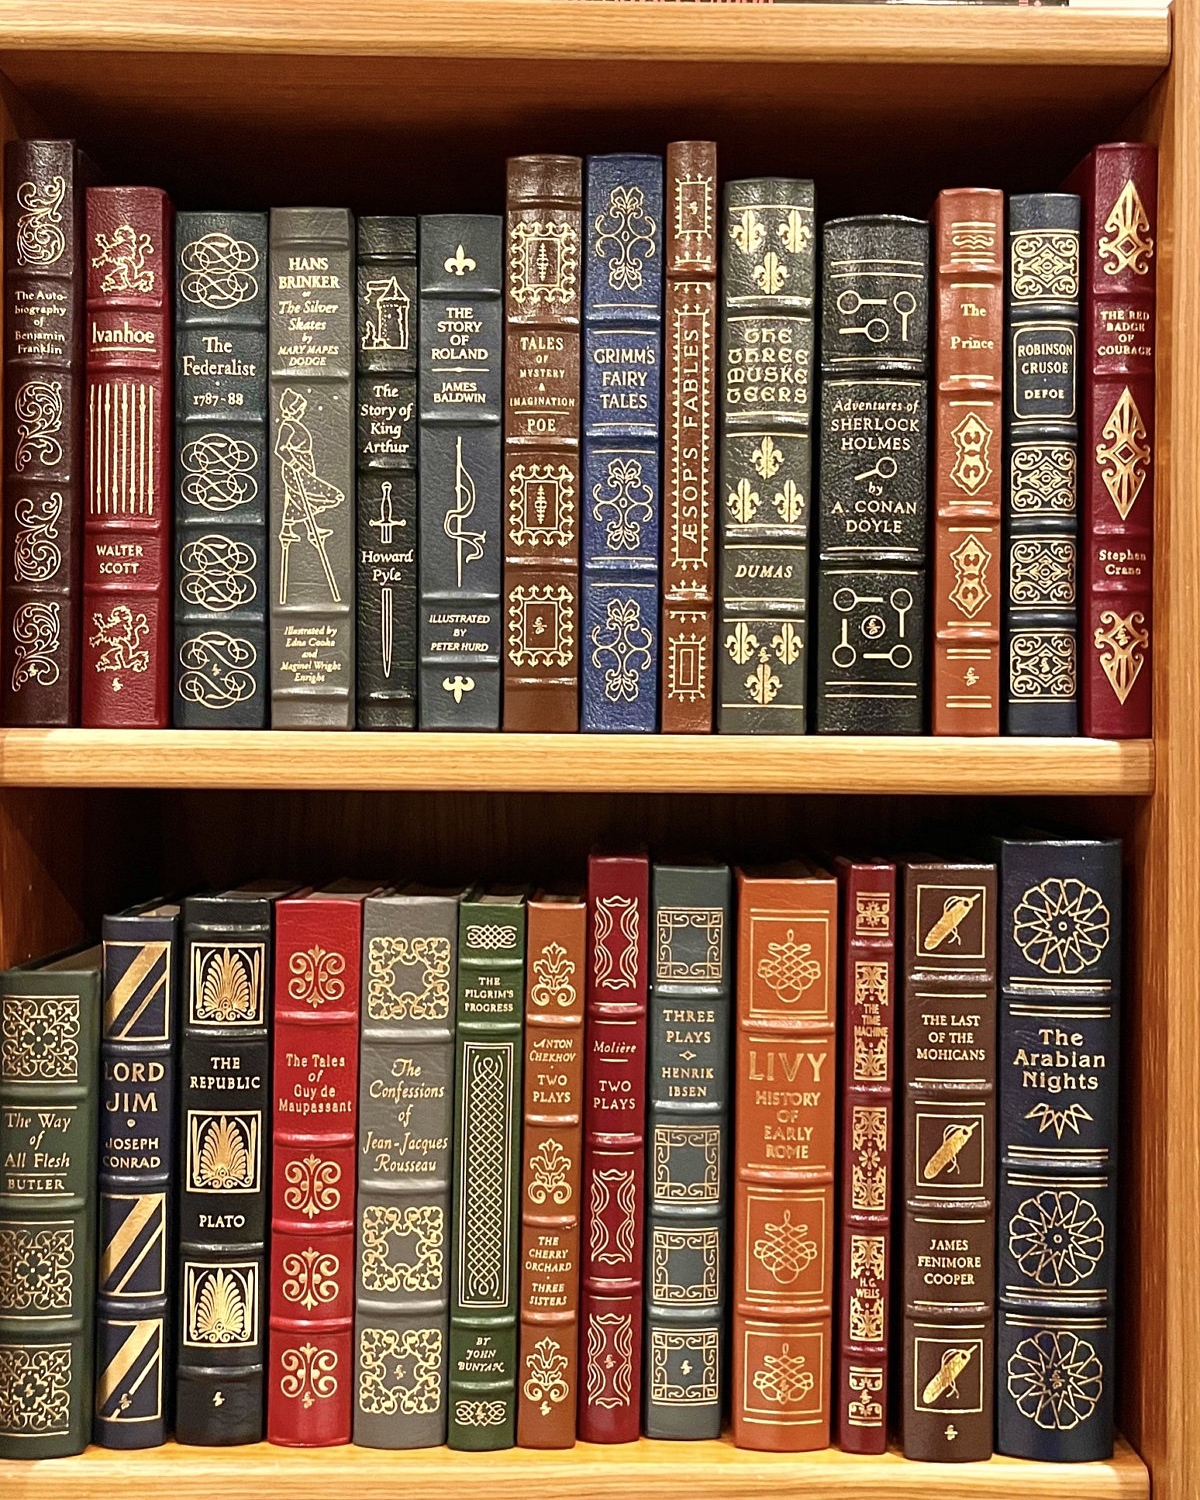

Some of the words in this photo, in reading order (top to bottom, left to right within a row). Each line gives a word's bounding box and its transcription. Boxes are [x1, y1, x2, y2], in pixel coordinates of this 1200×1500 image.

[288, 256, 329, 271] HANS
[278, 275, 341, 290] BRINKER
[92, 320, 155, 344] Ivanhoe
[519, 336, 564, 352] TALES
[950, 335, 994, 350] Prince
[431, 347, 489, 360] ROLAND
[1017, 343, 1073, 358] ROBINSON
[182, 355, 257, 377] Federalist
[1021, 361, 1069, 375] CRUSOE
[682, 329, 699, 428] FABLES
[433, 392, 487, 404] BALDWIN
[830, 417, 920, 433] SHERLOCK
[840, 436, 911, 451] HOLMES
[682, 447, 698, 544] ÆSOP'S
[845, 517, 903, 534] DOYLE
[95, 544, 144, 557] WALTER
[361, 548, 414, 568] Howard
[99, 562, 140, 575] SCOTT
[371, 565, 402, 587] Pyle
[734, 564, 793, 579] DUMAS
[662, 1009, 715, 1023] THREE
[666, 1030, 711, 1044] PLAYS
[1038, 1028, 1084, 1047] The
[916, 1047, 986, 1061] MOHICANS
[1012, 1048, 1106, 1068] Arabian
[189, 1075, 261, 1090] REPUBLIC
[1022, 1070, 1099, 1094] Nights
[293, 1083, 317, 1101] Guy
[320, 1084, 336, 1098] de
[369, 1079, 445, 1105] Confessions
[668, 1085, 707, 1097] IBSEN
[593, 1097, 636, 1110] PLAYS
[8, 1178, 65, 1190] BUTLER
[199, 1214, 246, 1228] PLATO
[923, 1272, 975, 1286] COOPER
